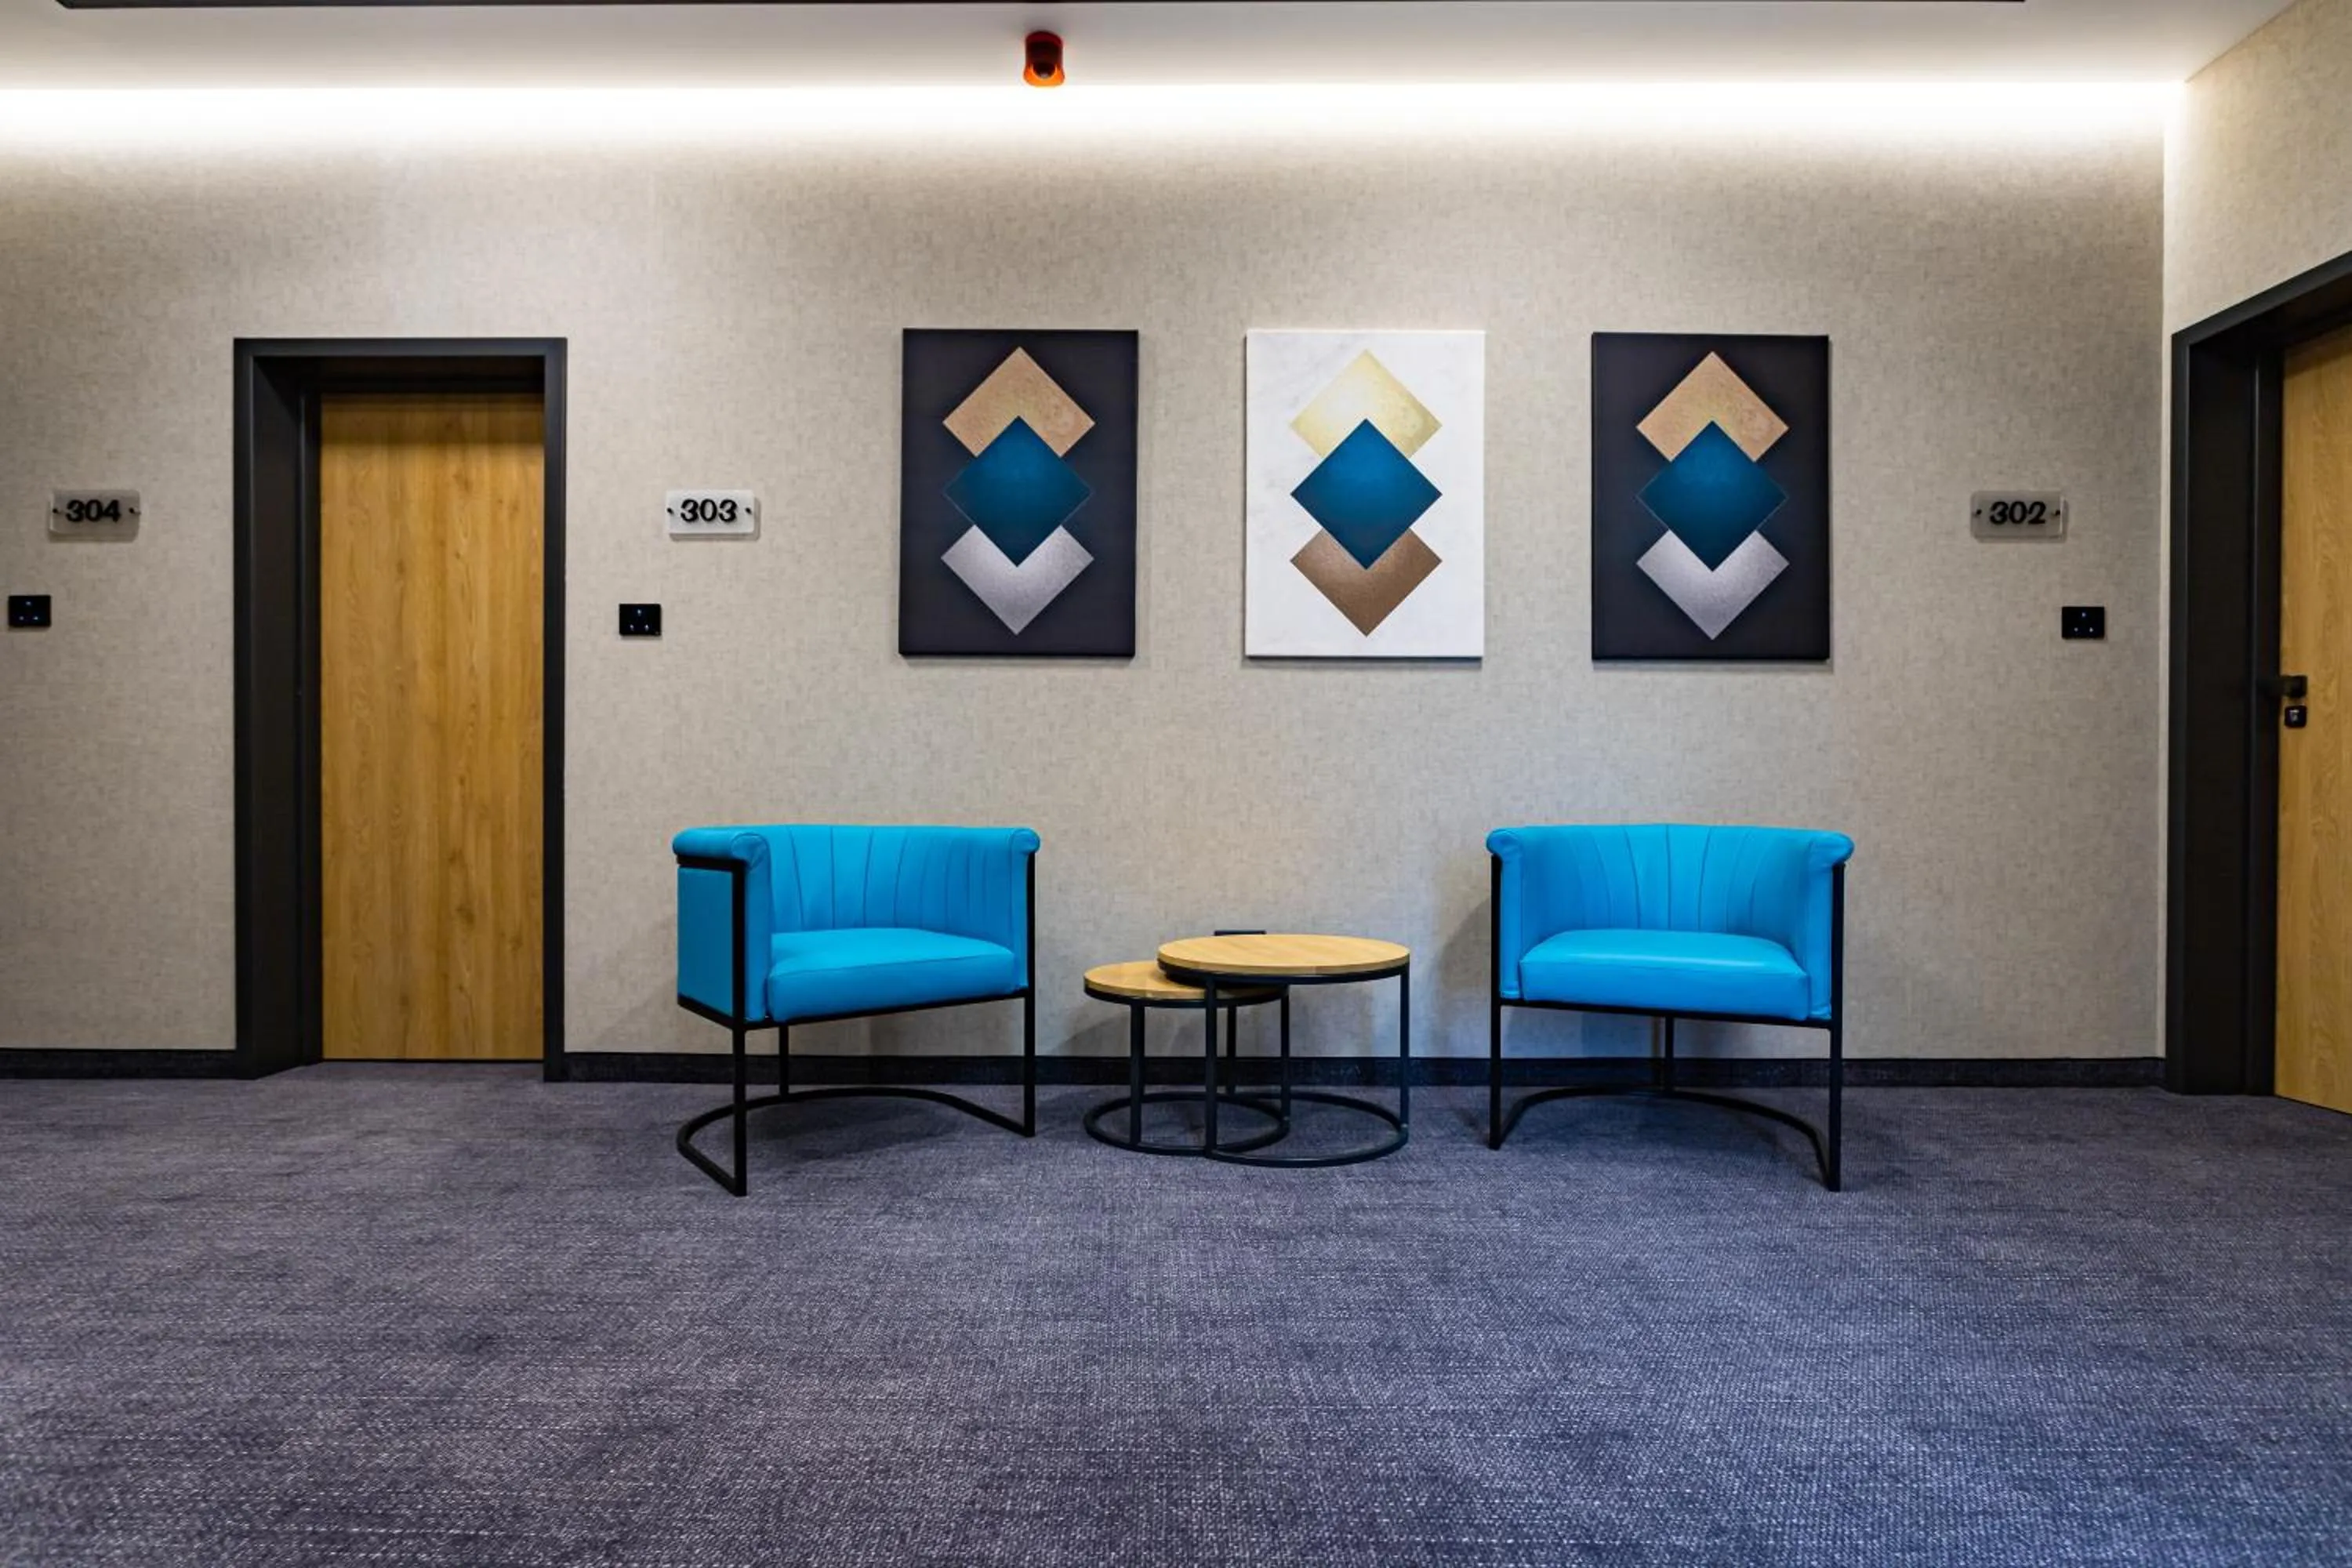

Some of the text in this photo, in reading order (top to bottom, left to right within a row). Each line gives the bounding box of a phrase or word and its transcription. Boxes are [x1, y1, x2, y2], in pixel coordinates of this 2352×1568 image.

[66, 499, 122, 523] 304
[681, 499, 738, 523] 303
[1990, 501, 2046, 524] 302
